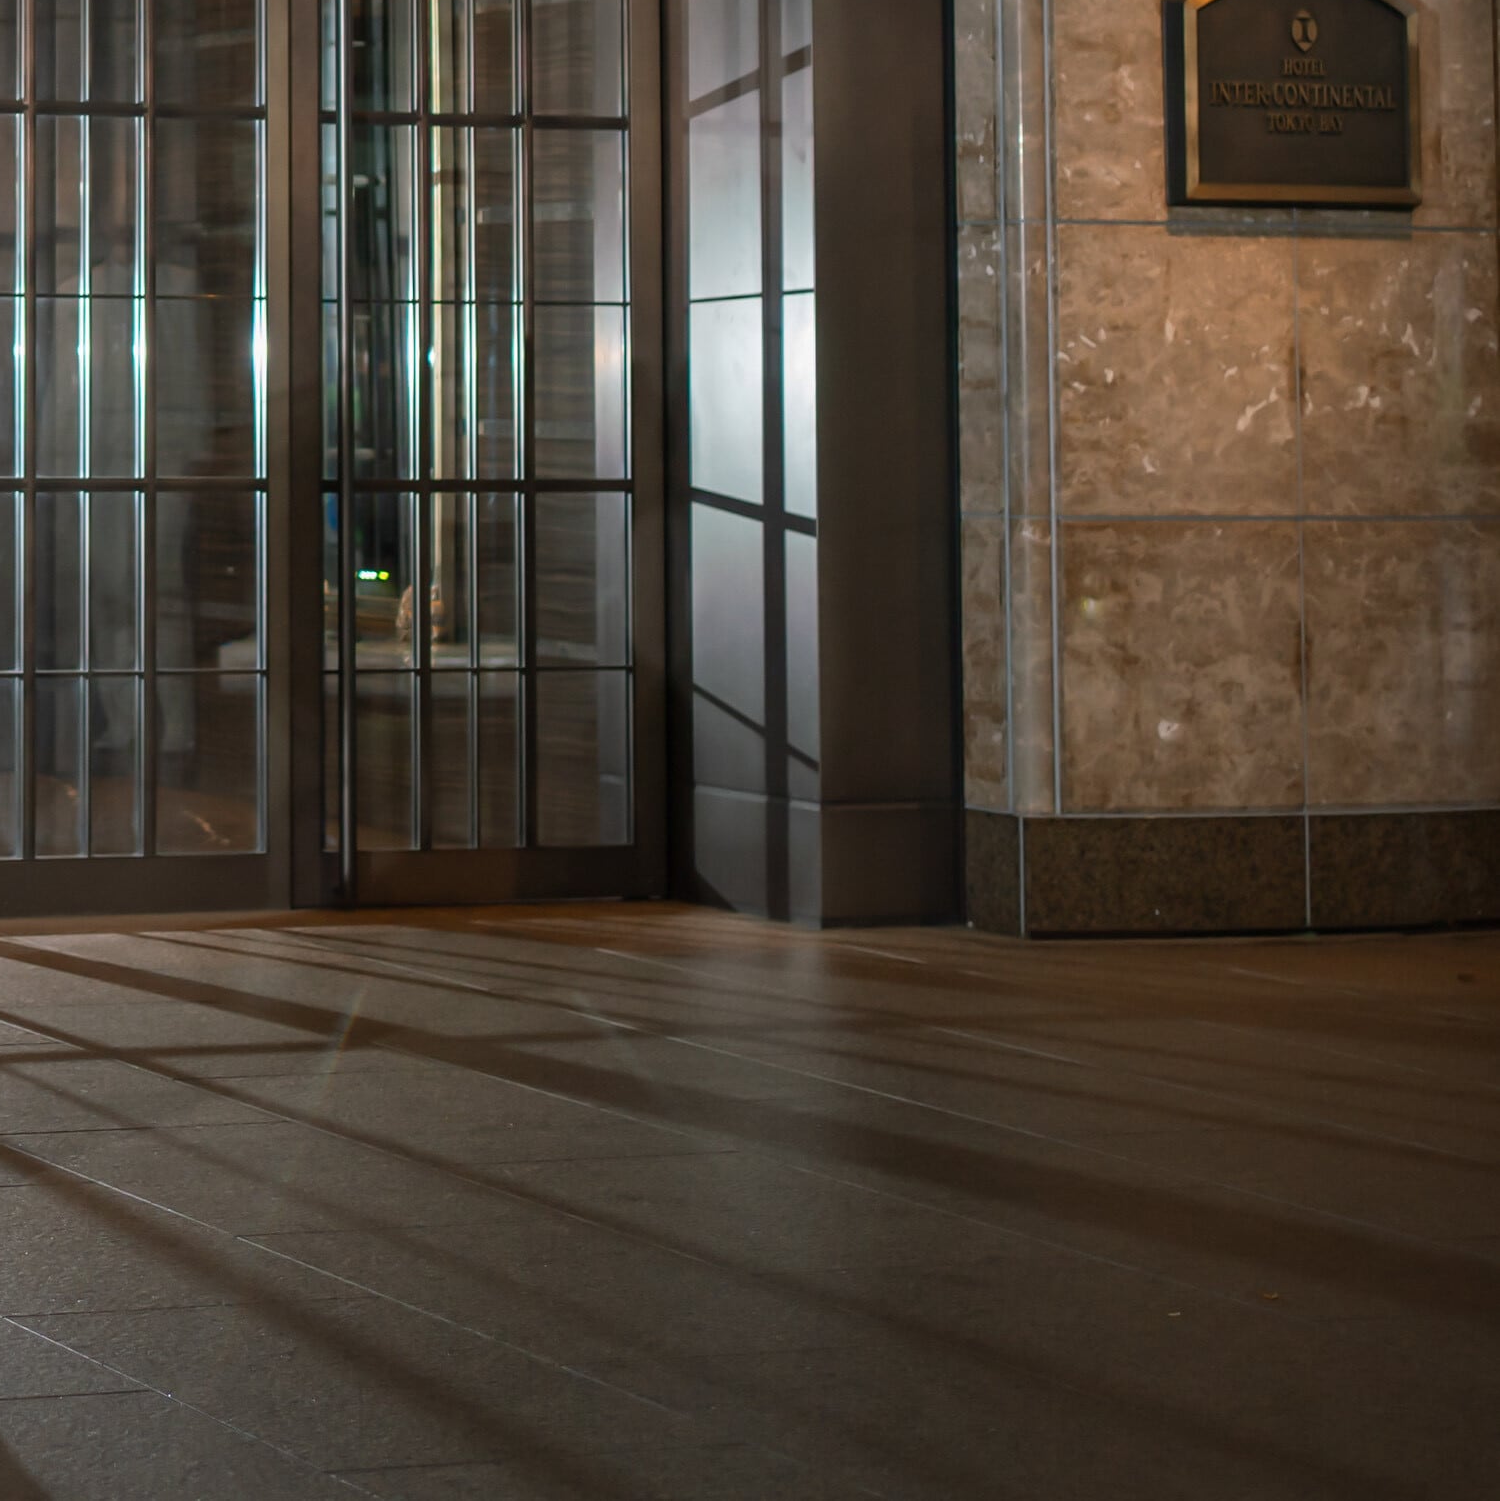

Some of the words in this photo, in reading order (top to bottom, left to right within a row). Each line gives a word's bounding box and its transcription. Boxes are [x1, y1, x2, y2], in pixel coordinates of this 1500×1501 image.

[1283, 58, 1326, 75] HOTEL
[1269, 114, 1315, 132] TOKYO
[1320, 115, 1344, 133] BAY
